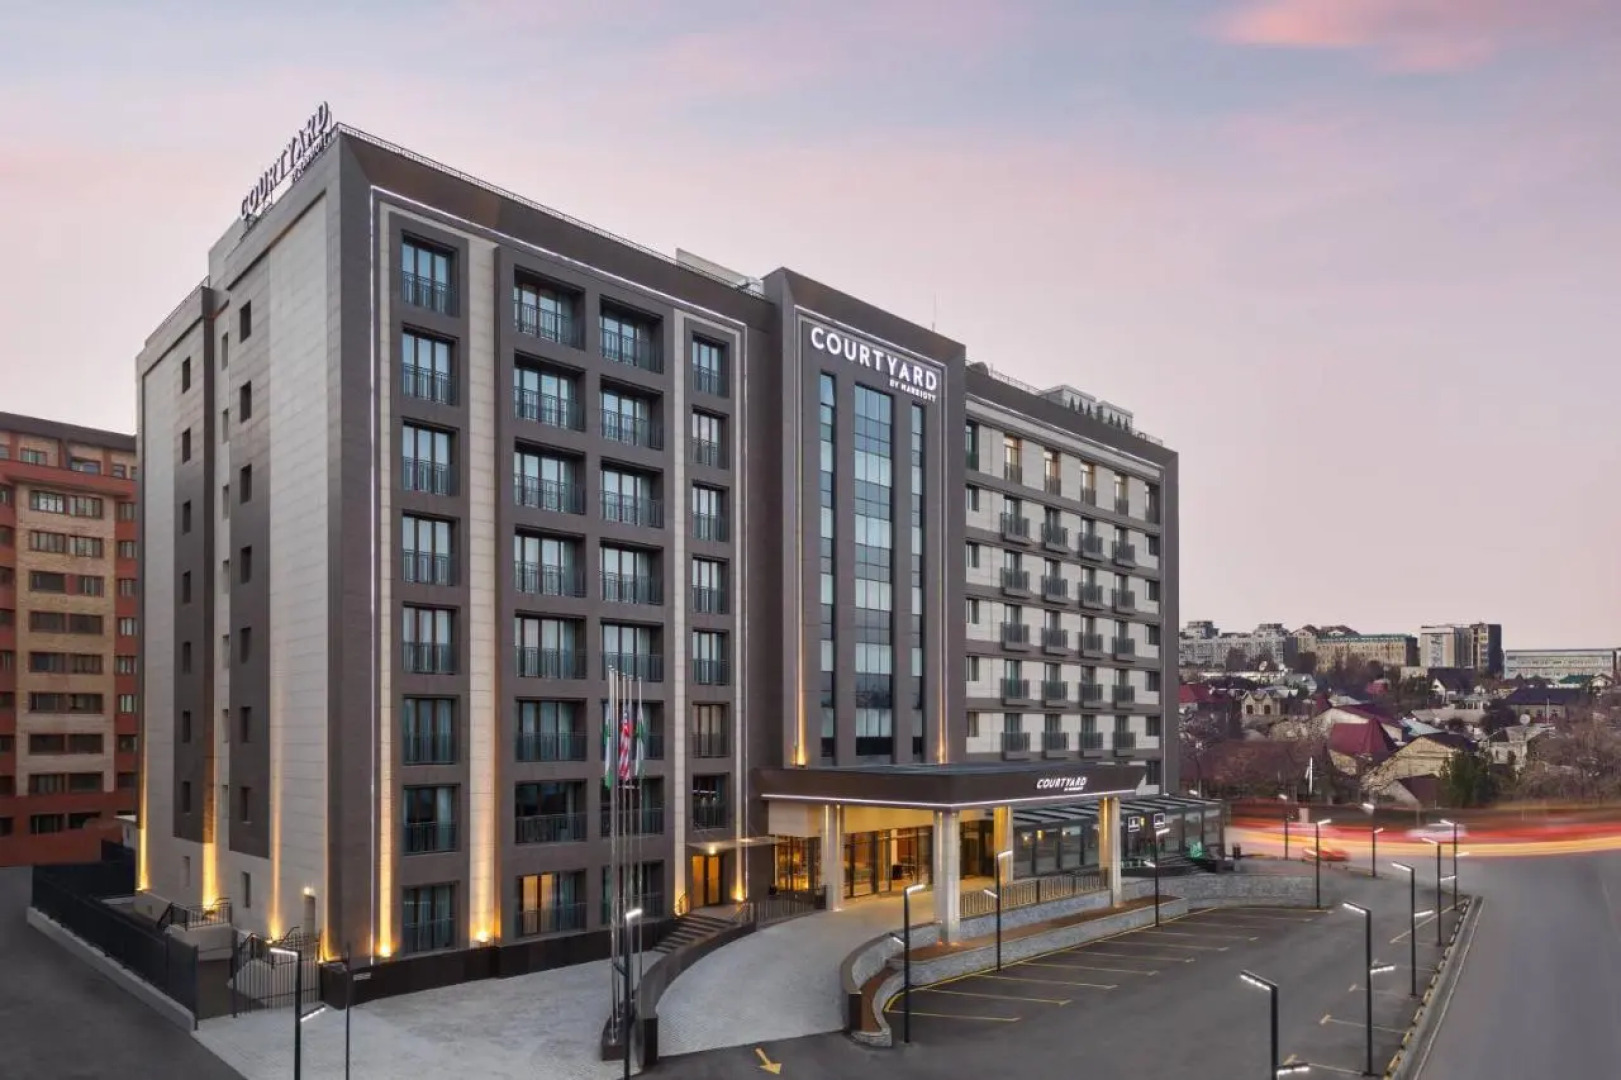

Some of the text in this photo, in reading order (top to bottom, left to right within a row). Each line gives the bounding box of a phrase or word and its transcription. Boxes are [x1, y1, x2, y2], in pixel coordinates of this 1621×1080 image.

[811, 326, 937, 391] COURTYARD
[889, 378, 937, 402] BY MARRIOTT
[1036, 776, 1087, 789] COURTYARD
